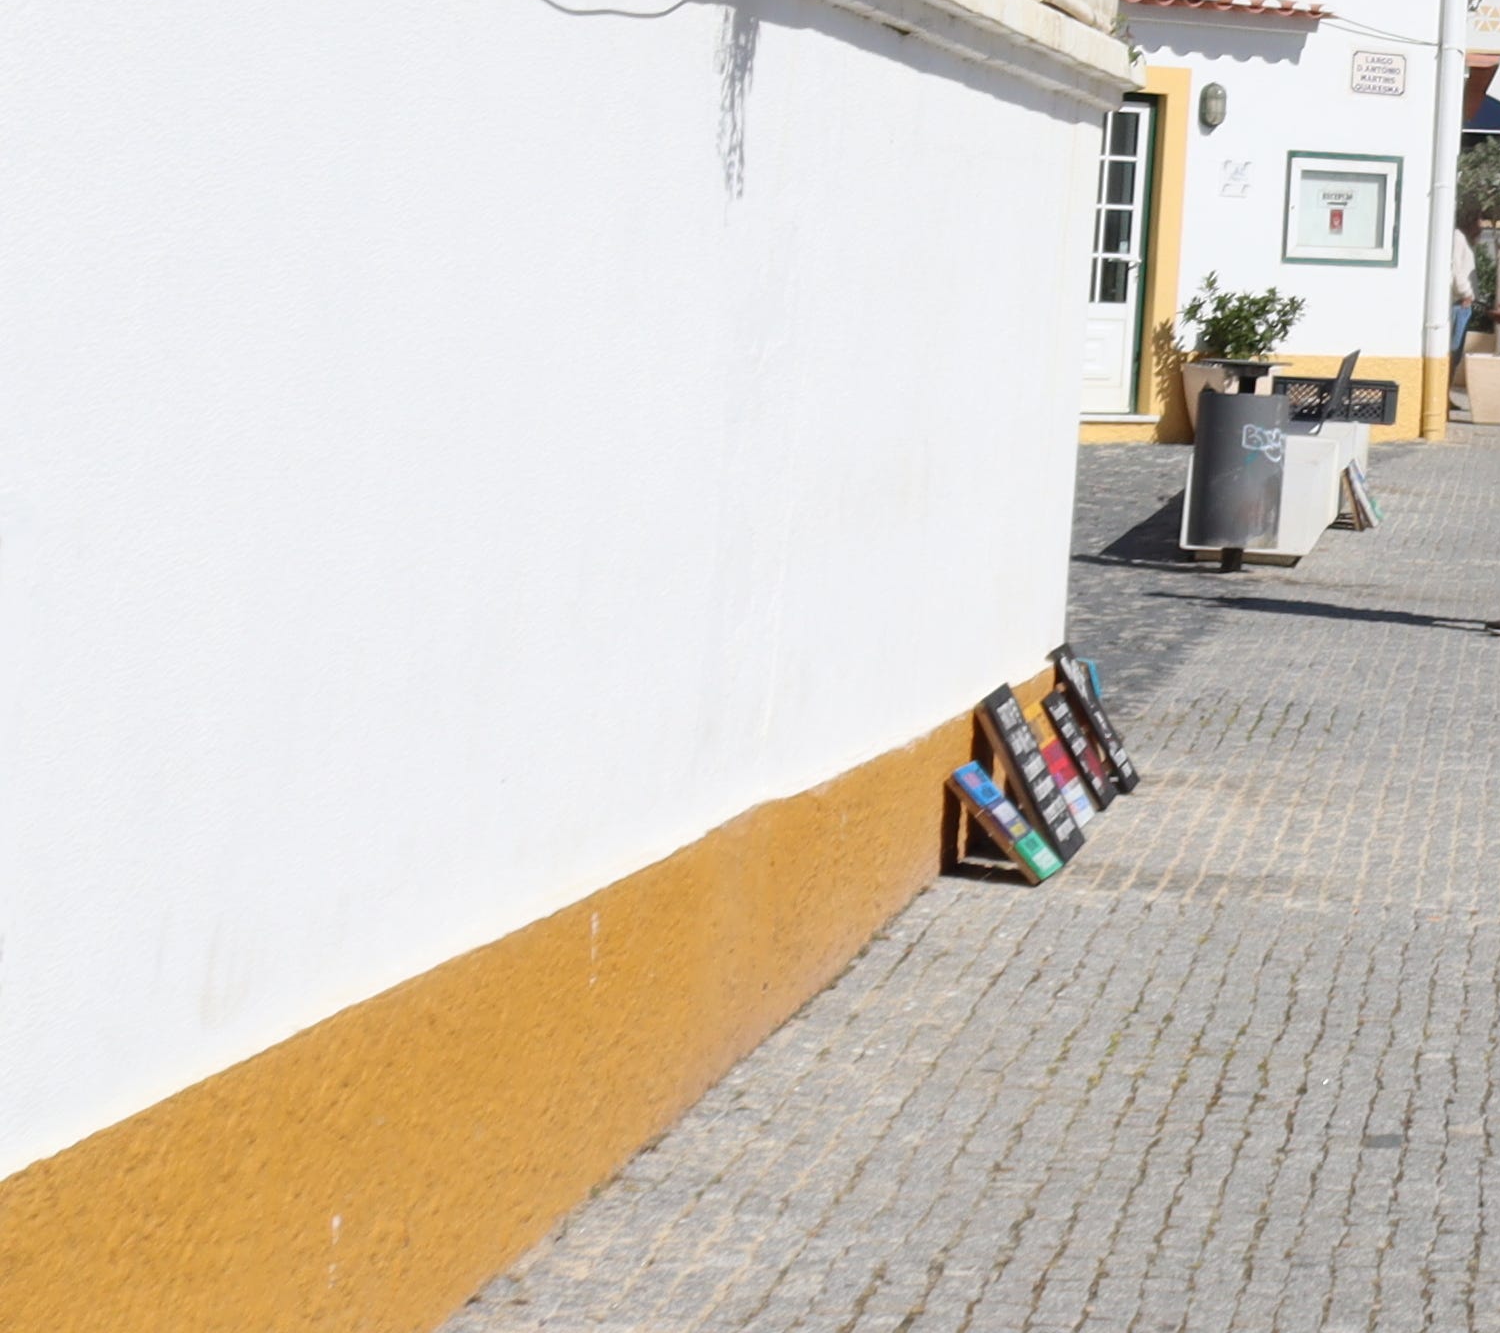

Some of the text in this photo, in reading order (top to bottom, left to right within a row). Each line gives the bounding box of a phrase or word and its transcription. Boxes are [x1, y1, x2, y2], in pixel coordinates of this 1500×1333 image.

[1365, 56, 1393, 65] LARGO
[1360, 74, 1396, 84] MARTINS
[1354, 83, 1399, 94] QUARESMA
